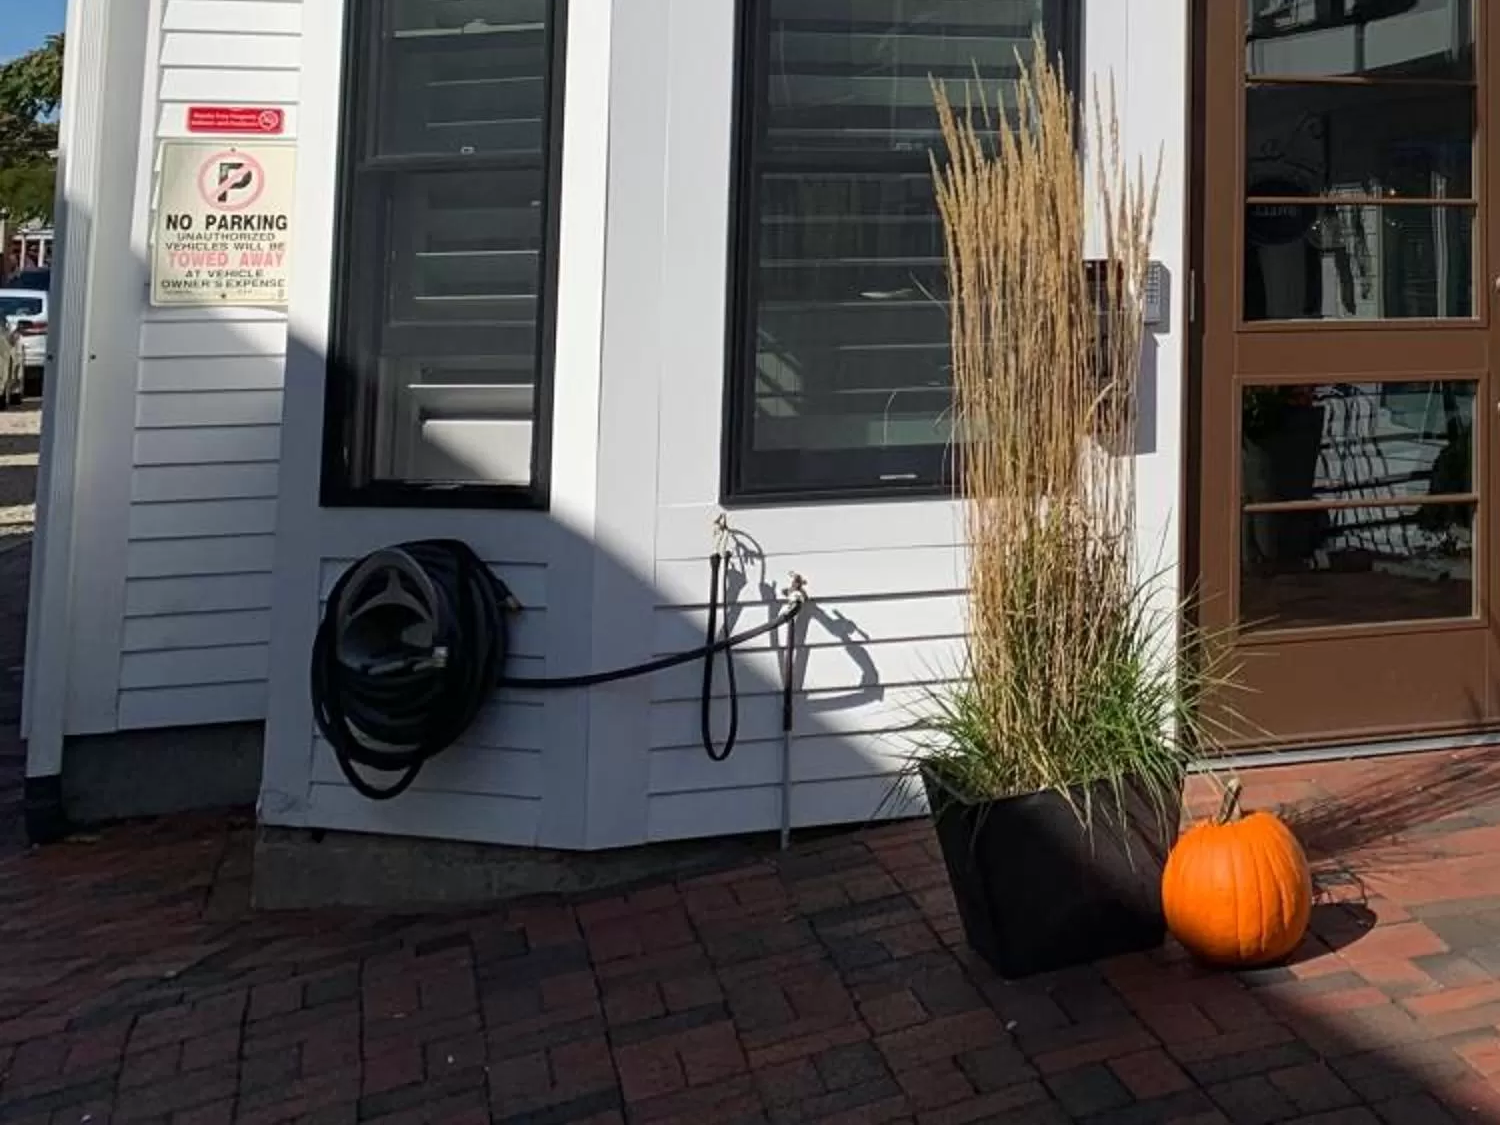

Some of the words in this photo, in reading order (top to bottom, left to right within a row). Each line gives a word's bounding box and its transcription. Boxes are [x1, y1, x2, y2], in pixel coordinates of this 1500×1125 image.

[167, 214, 192, 230] NO
[205, 214, 287, 230] PARKING
[177, 232, 276, 241] UNAUTHORIZED
[166, 242, 228, 251] VEHICLES
[233, 242, 264, 251] WILL
[270, 242, 285, 251] BE
[168, 251, 228, 267] TOWED
[239, 251, 284, 267] AWAY
[185, 269, 200, 278] AT
[208, 269, 264, 278] VEHICLE
[161, 278, 222, 288] OWNER'S
[226, 278, 286, 288] EXPENSE
